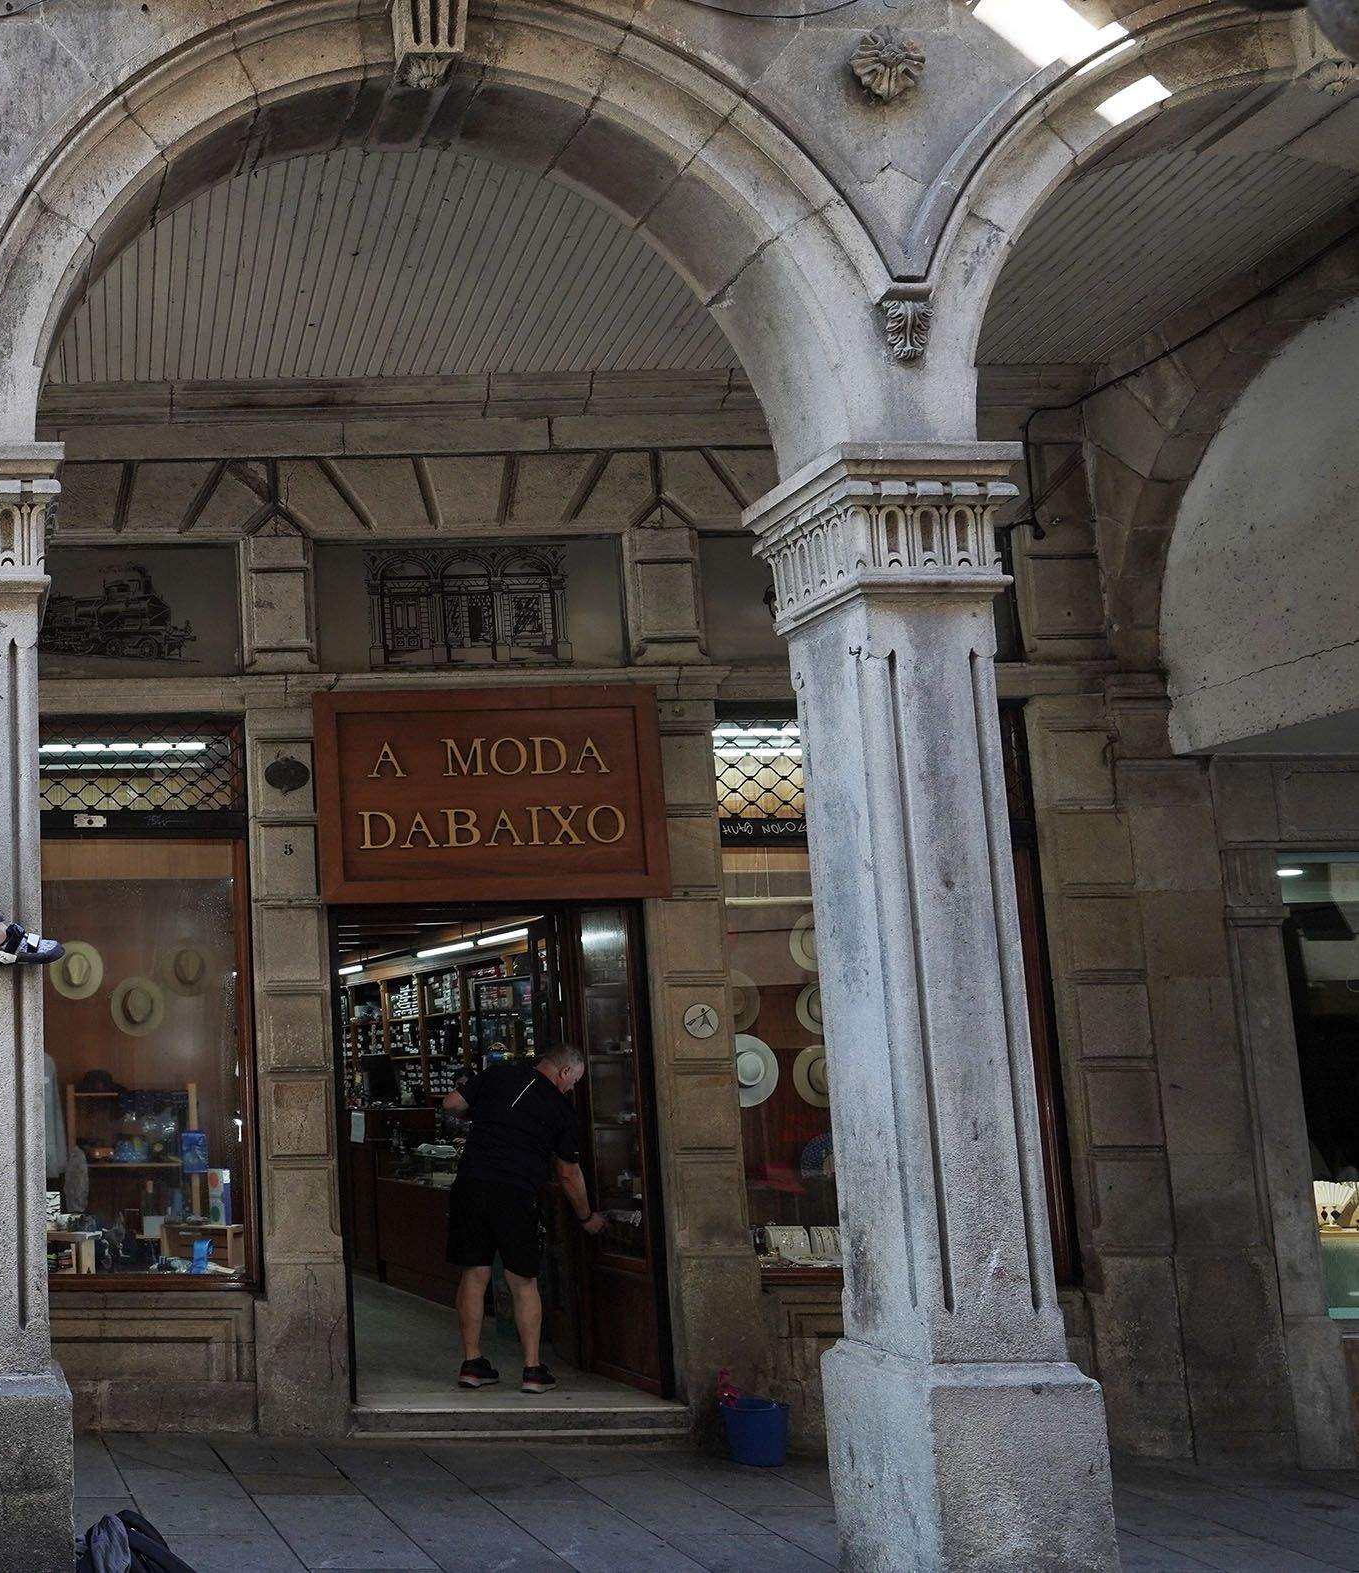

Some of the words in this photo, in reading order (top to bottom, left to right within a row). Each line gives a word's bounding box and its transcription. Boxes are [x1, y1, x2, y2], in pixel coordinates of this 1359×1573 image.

[367, 741, 407, 778] A
[440, 736, 610, 777] MODA
[358, 804, 626, 849] DABAIXO
